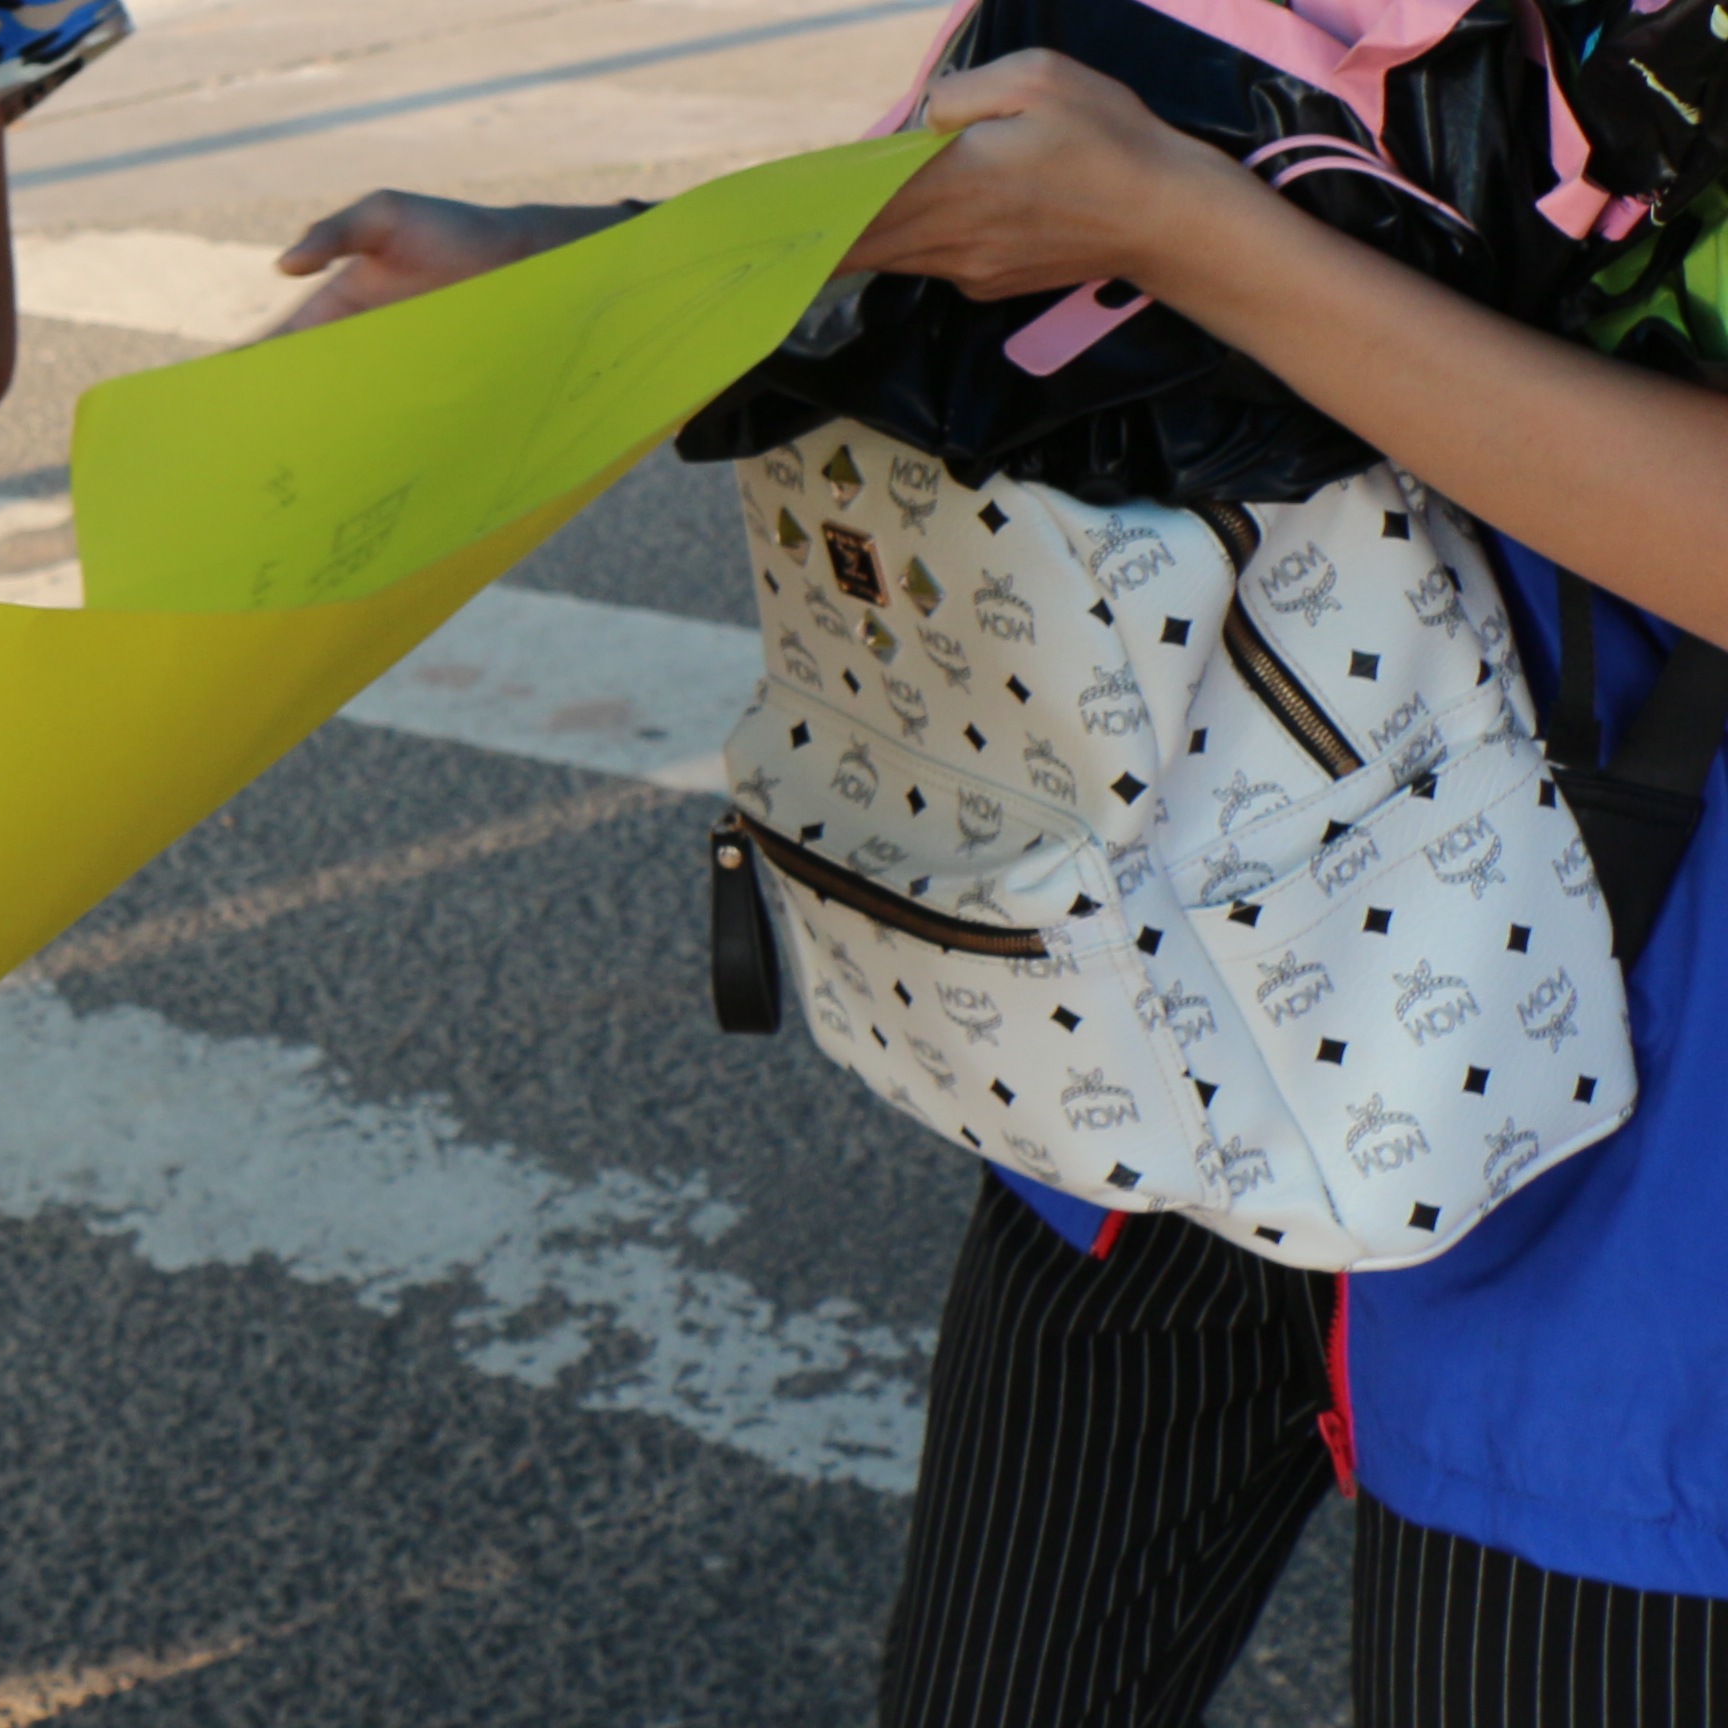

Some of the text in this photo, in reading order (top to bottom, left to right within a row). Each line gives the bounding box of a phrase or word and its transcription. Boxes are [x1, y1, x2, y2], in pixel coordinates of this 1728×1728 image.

[1098, 541, 1175, 600] MCM
[1258, 541, 1327, 600] MCM
[976, 607, 1035, 645] MCM
[1369, 691, 1430, 752] MCM
[1327, 838, 1380, 897] MCM
[1422, 812, 1494, 870] MCM
[1262, 972, 1334, 1027] MCM
[1405, 990, 1481, 1046] MCM
[1517, 966, 1574, 1026] MCM
[1062, 1101, 1140, 1131] MCM
[1352, 1128, 1430, 1178] MCM
